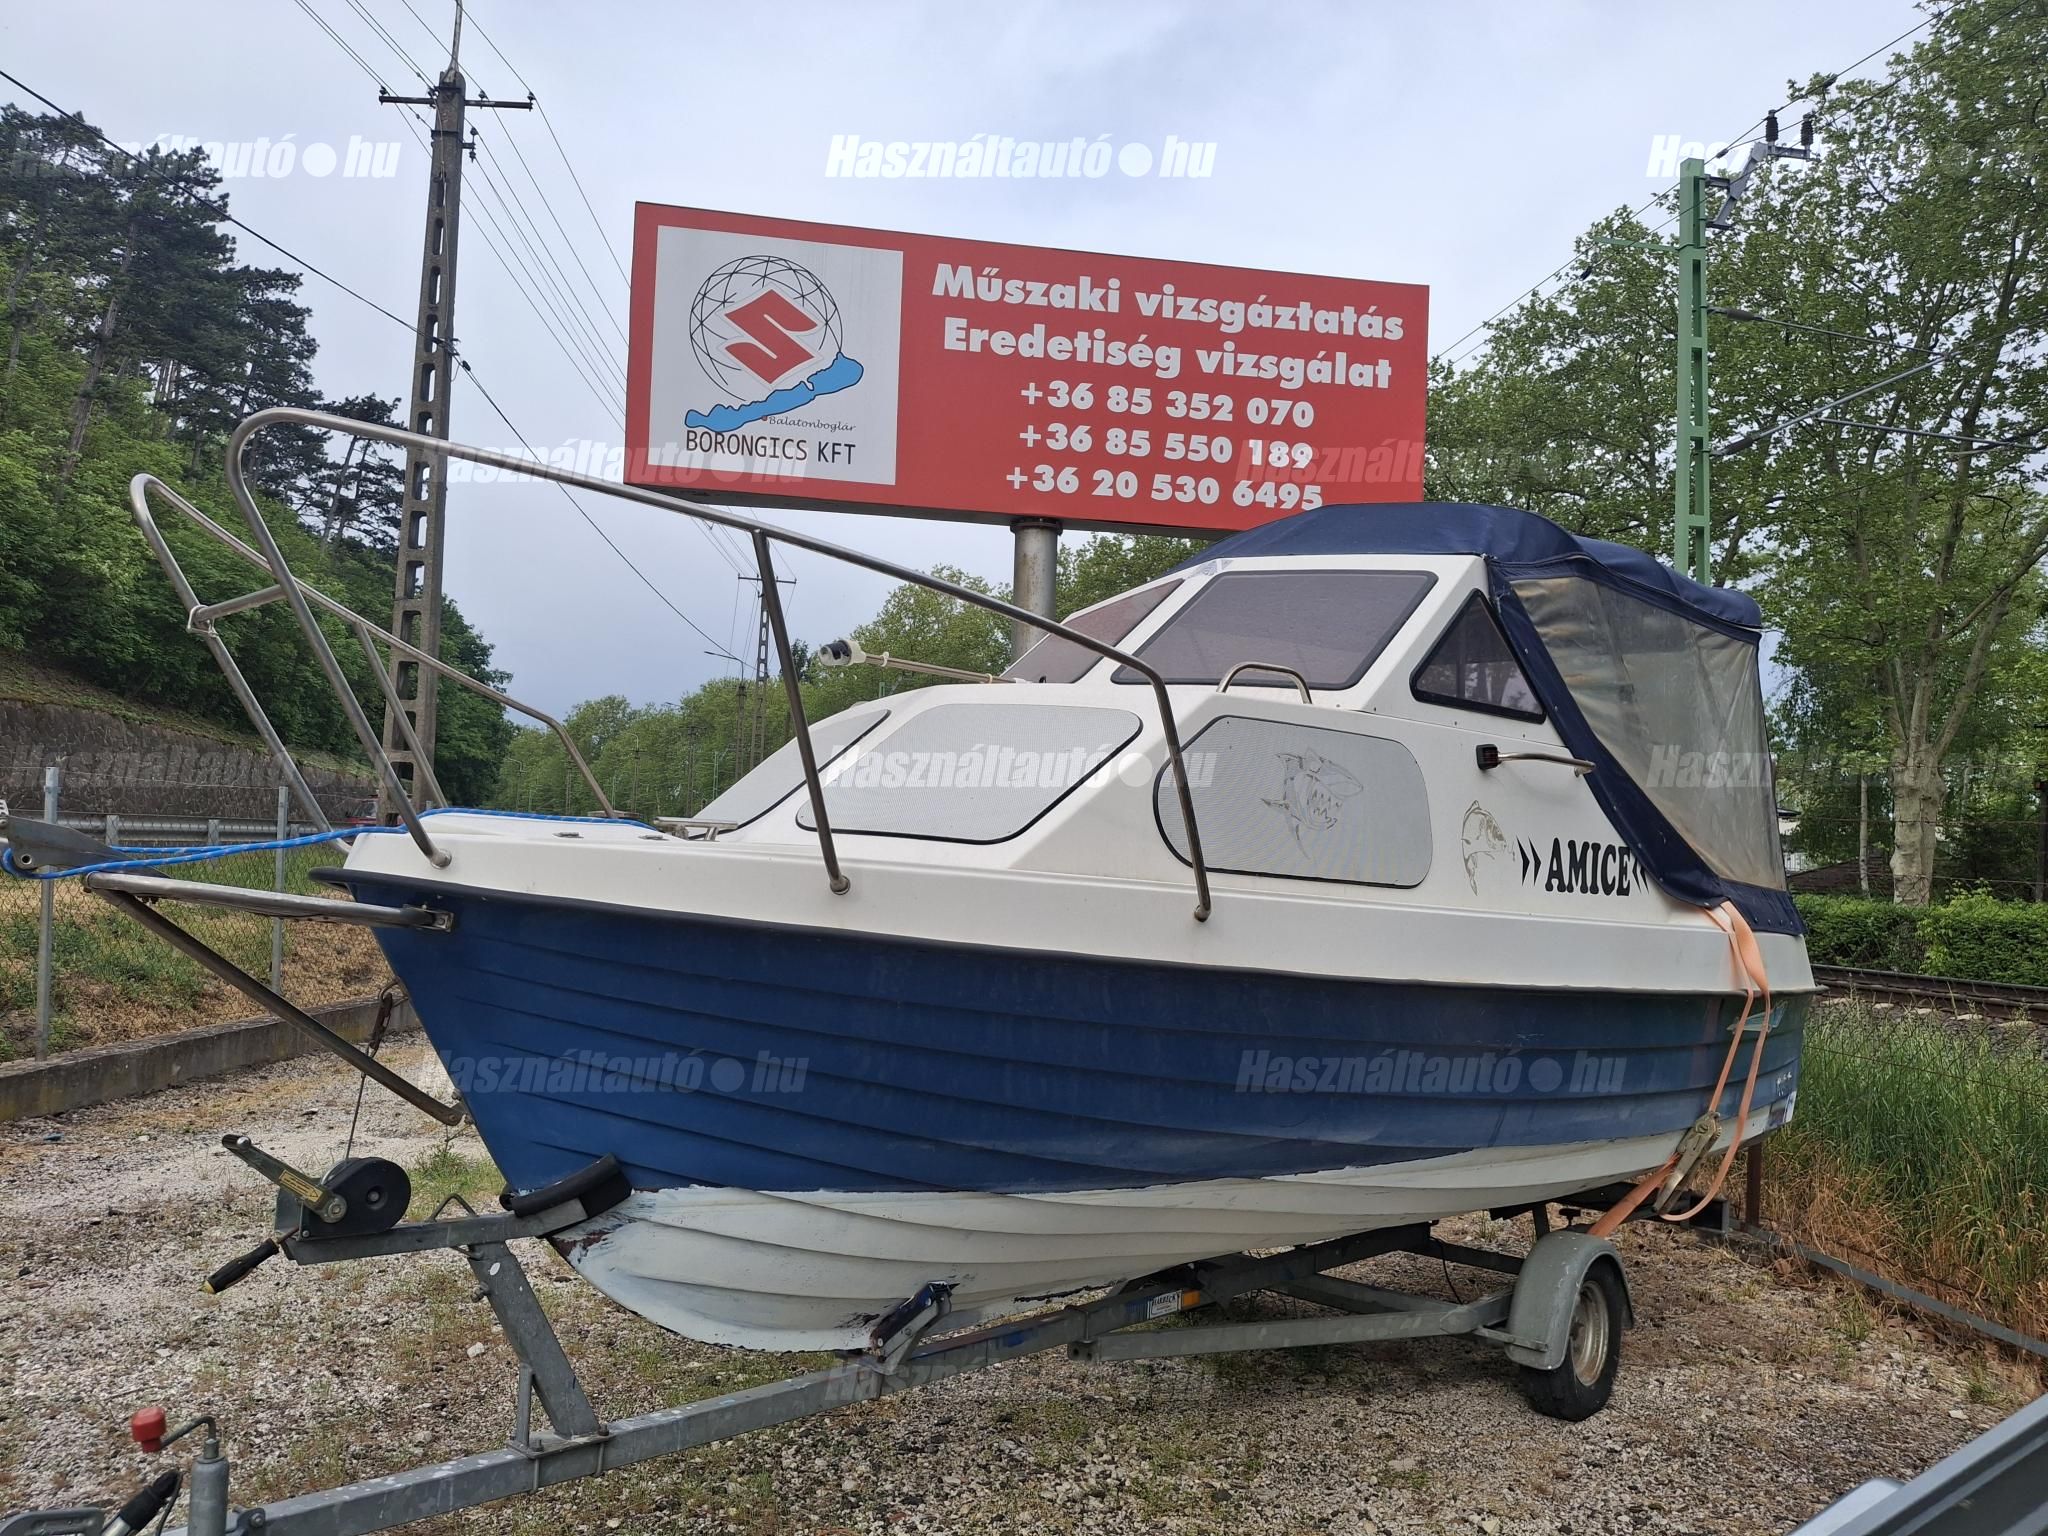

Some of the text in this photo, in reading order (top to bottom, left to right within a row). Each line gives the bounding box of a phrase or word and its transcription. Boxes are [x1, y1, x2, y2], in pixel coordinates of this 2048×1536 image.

[932, 263, 1404, 341] Műszaki vizsgáztatás
[944, 316, 1392, 390] Eredetiség vizsgálat
[769, 416, 857, 432] Balatonboglár
[1020, 380, 1315, 428] +36 85 352 070
[686, 429, 857, 465] BORONGICS KFT
[1019, 422, 1314, 469] +36 85 550 189
[1006, 464, 1323, 511] +36 20 530 6495
[1545, 837, 1631, 896] AMICE
